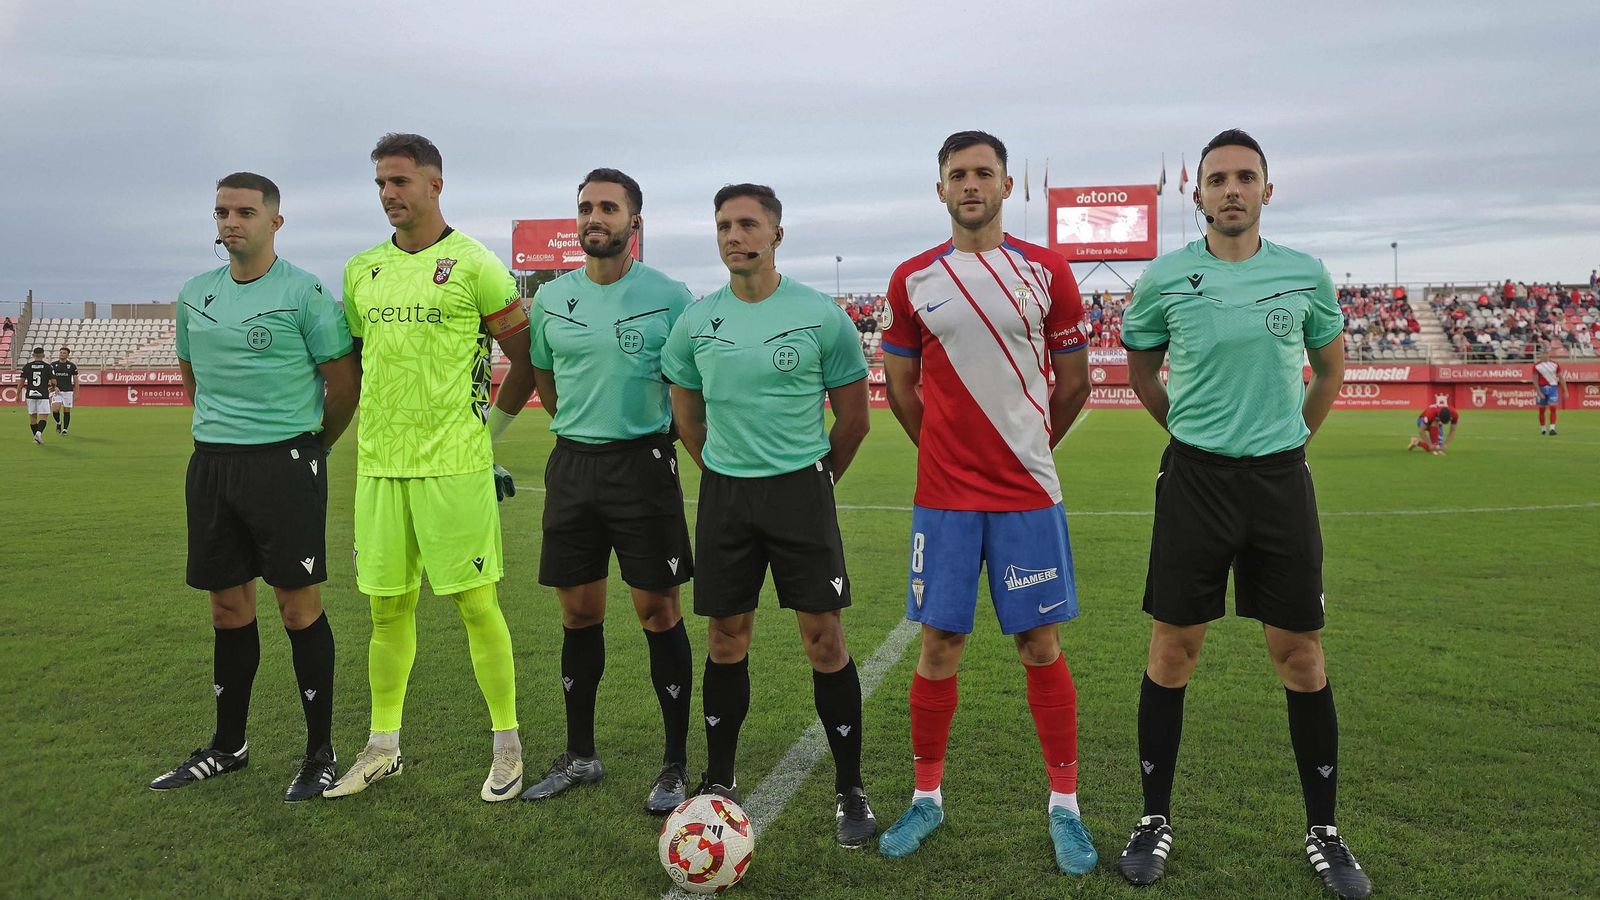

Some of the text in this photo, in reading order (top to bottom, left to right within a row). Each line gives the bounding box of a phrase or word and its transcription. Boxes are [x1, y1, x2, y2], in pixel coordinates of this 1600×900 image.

[1076, 190, 1128, 203] datono
[1103, 247, 1112, 255] de
[367, 302, 444, 324] ceuta
[1062, 336, 1078, 347] 500
[32, 371, 42, 387] 5
[115, 372, 147, 384] Limpiasol
[912, 532, 925, 573] 8
